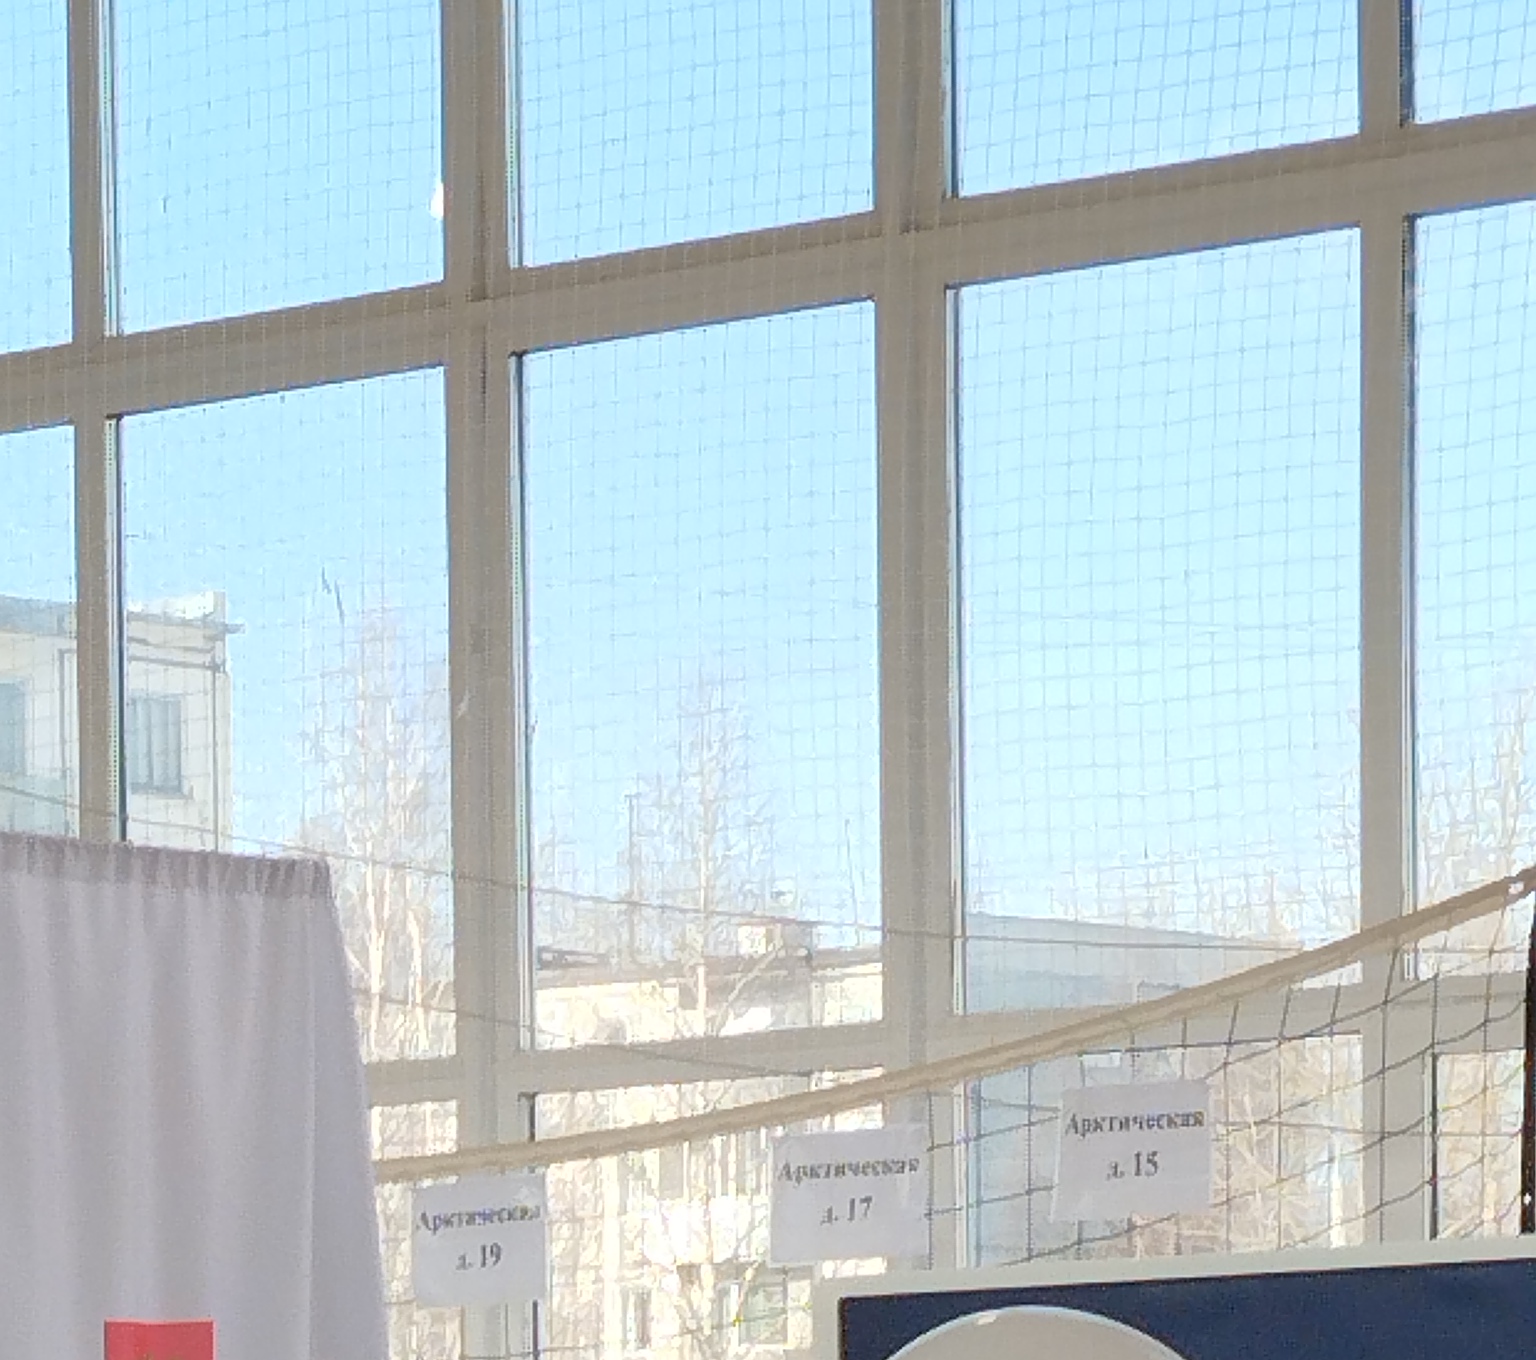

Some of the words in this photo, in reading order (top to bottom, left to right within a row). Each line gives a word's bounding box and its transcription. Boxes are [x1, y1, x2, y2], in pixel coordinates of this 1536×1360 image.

[1064, 1110, 1205, 1139] Арктическая
[777, 1157, 920, 1189] Арктическая
[1105, 1161, 1124, 1181] д.
[1134, 1150, 1158, 1177] 15
[819, 1205, 838, 1226] д.
[847, 1195, 873, 1223] 17
[479, 1242, 502, 1268] 19
